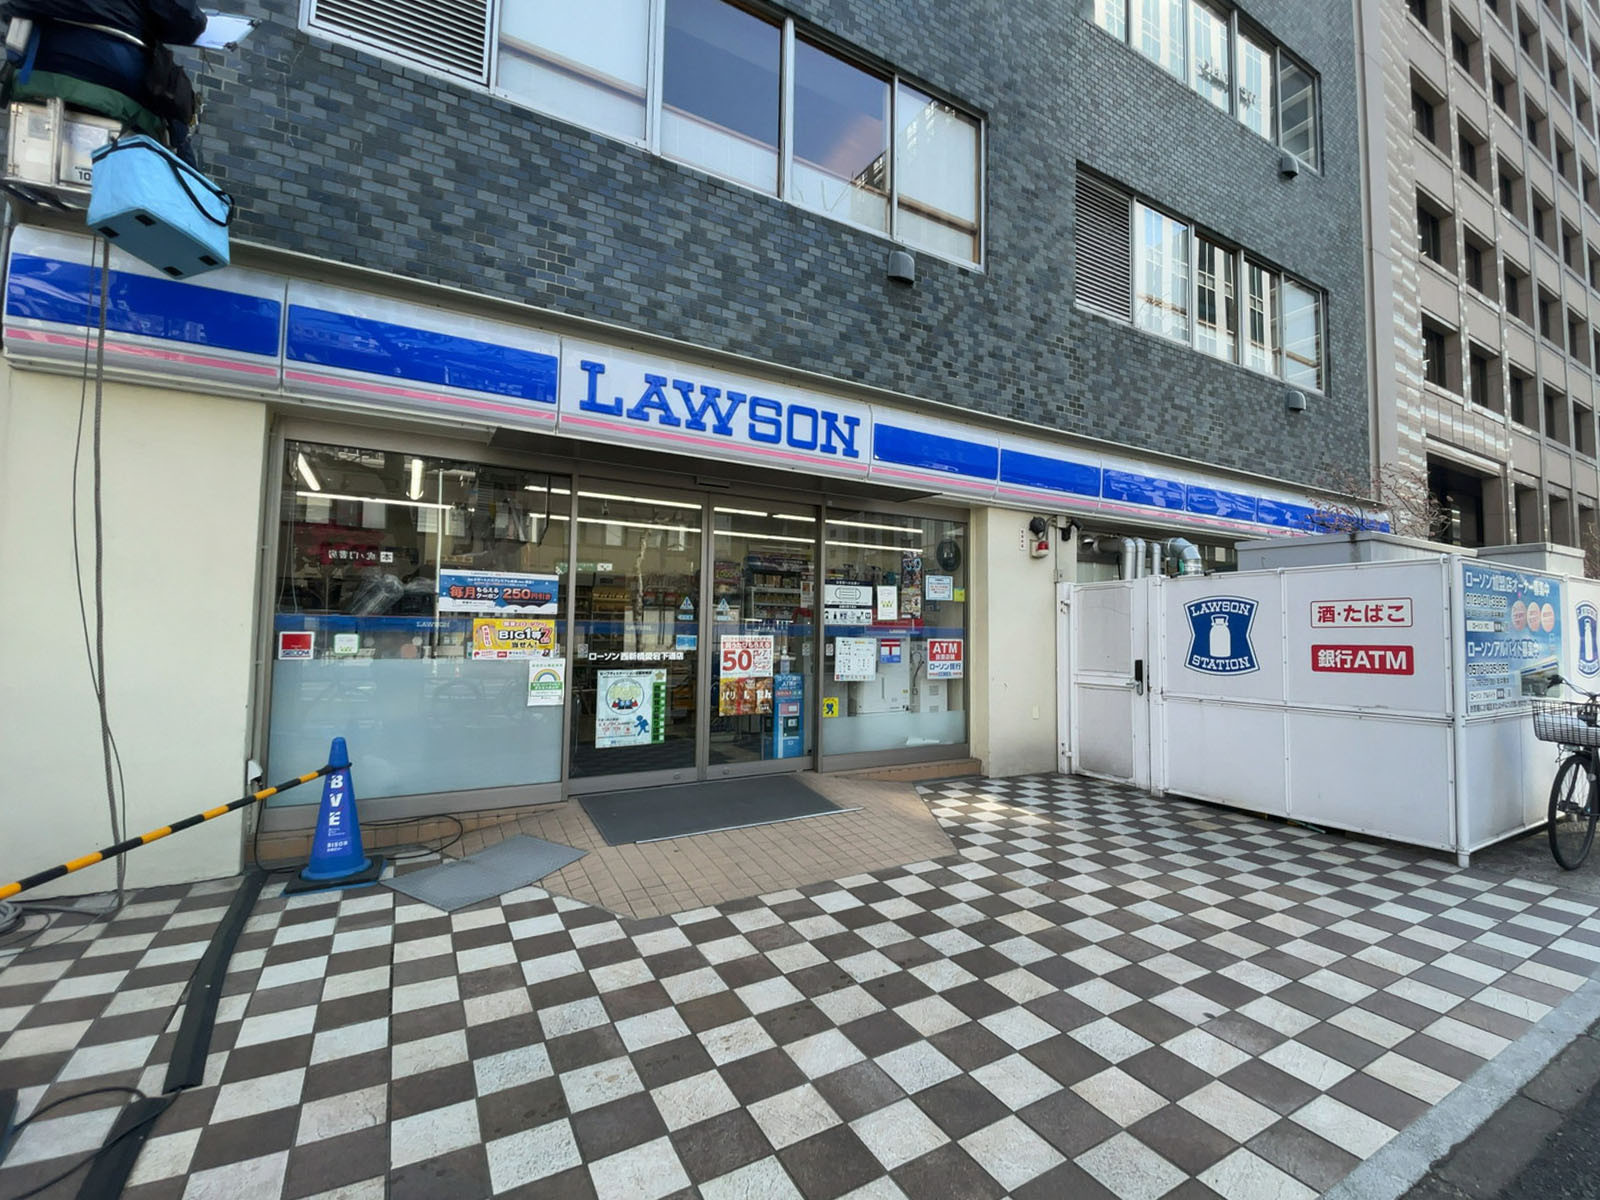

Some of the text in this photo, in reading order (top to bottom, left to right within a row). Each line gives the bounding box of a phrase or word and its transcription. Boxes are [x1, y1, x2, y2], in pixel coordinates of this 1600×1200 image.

[579, 359, 861, 459] LAWSON
[449, 585, 476, 599] 毎月
[1191, 601, 1252, 617] LAWSON
[932, 642, 958, 654] ATM
[722, 650, 753, 672] 50
[929, 662, 962, 671] ローソン銀行
[1191, 656, 1252, 671] STATION
[1318, 649, 1407, 671] 銀行ATM
[328, 774, 344, 826] BVE
